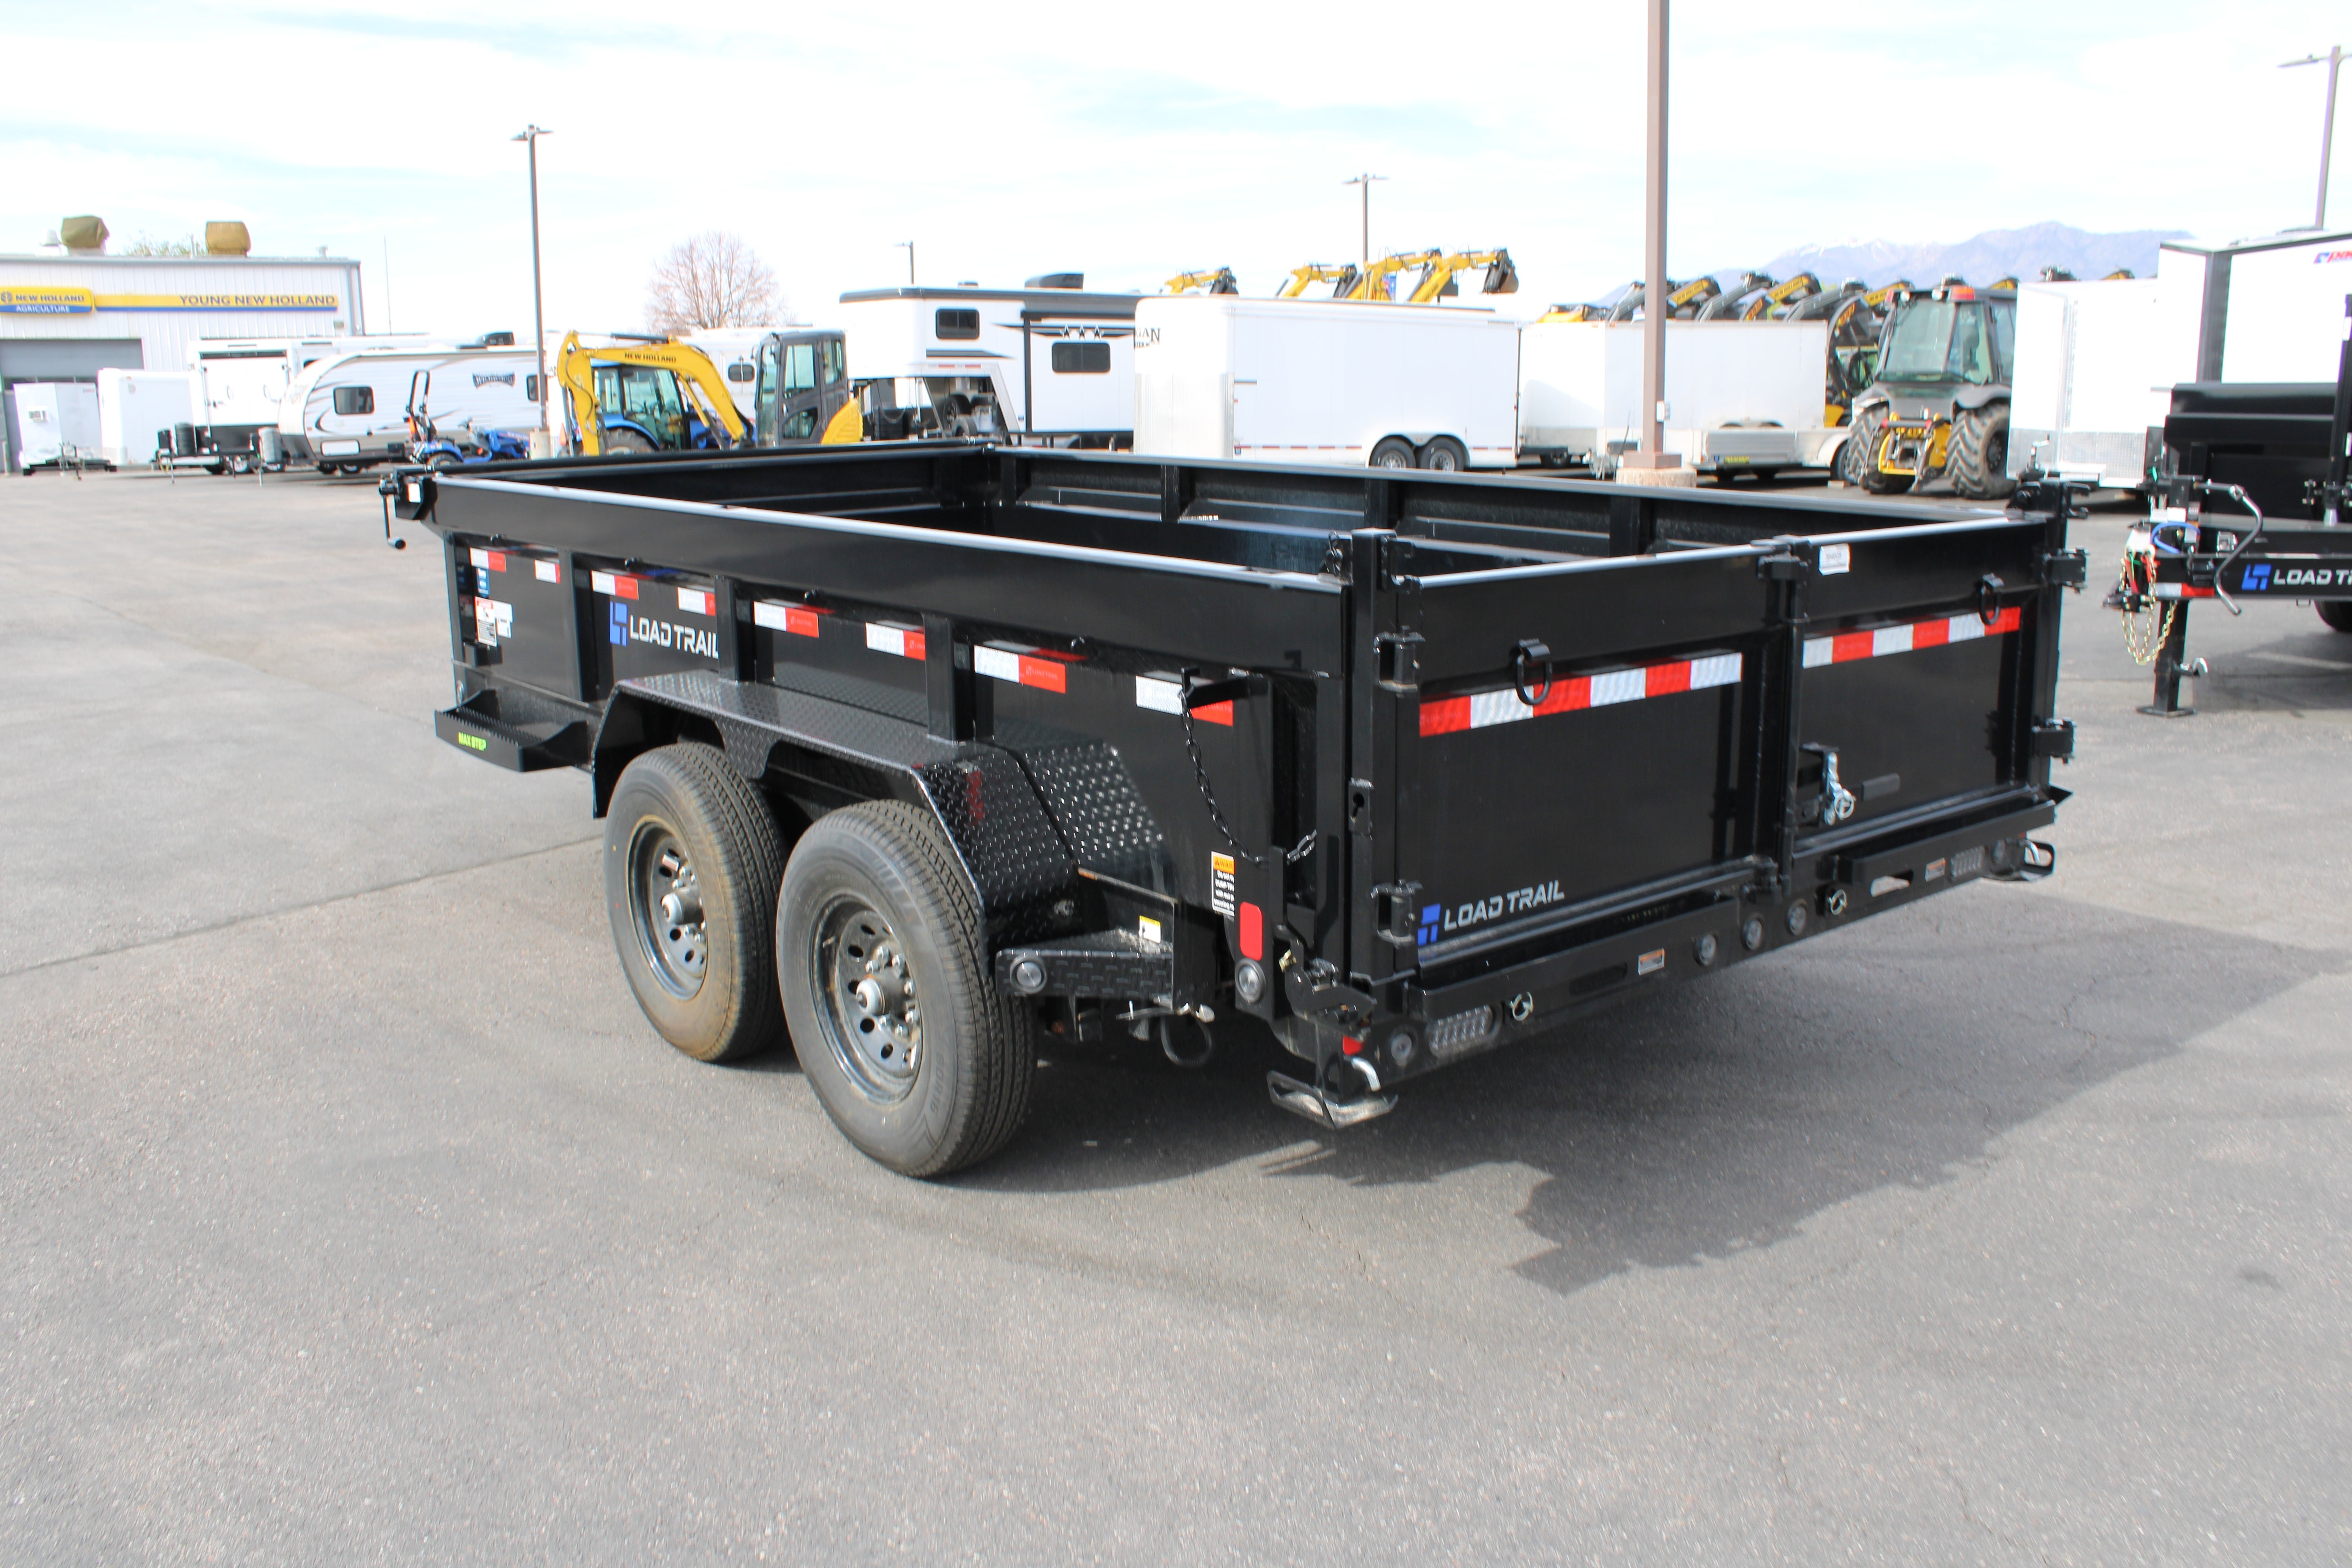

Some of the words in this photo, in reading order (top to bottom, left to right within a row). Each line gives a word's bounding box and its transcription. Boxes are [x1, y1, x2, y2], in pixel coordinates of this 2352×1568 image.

[180, 295, 230, 305] YOUNG
[235, 295, 266, 305] NEW
[270, 295, 335, 305] HOLLAND
[16, 305, 70, 313] AGRICULTURE
[643, 354, 676, 362] HOLLAND
[2273, 569, 2332, 585] LOAD
[630, 614, 672, 648] LOAD
[674, 624, 719, 659] TRAIL
[458, 731, 471, 747] MAX
[471, 735, 487, 752] STEP
[1444, 895, 1503, 931] LOAD
[1507, 880, 1565, 913] TRAIL
